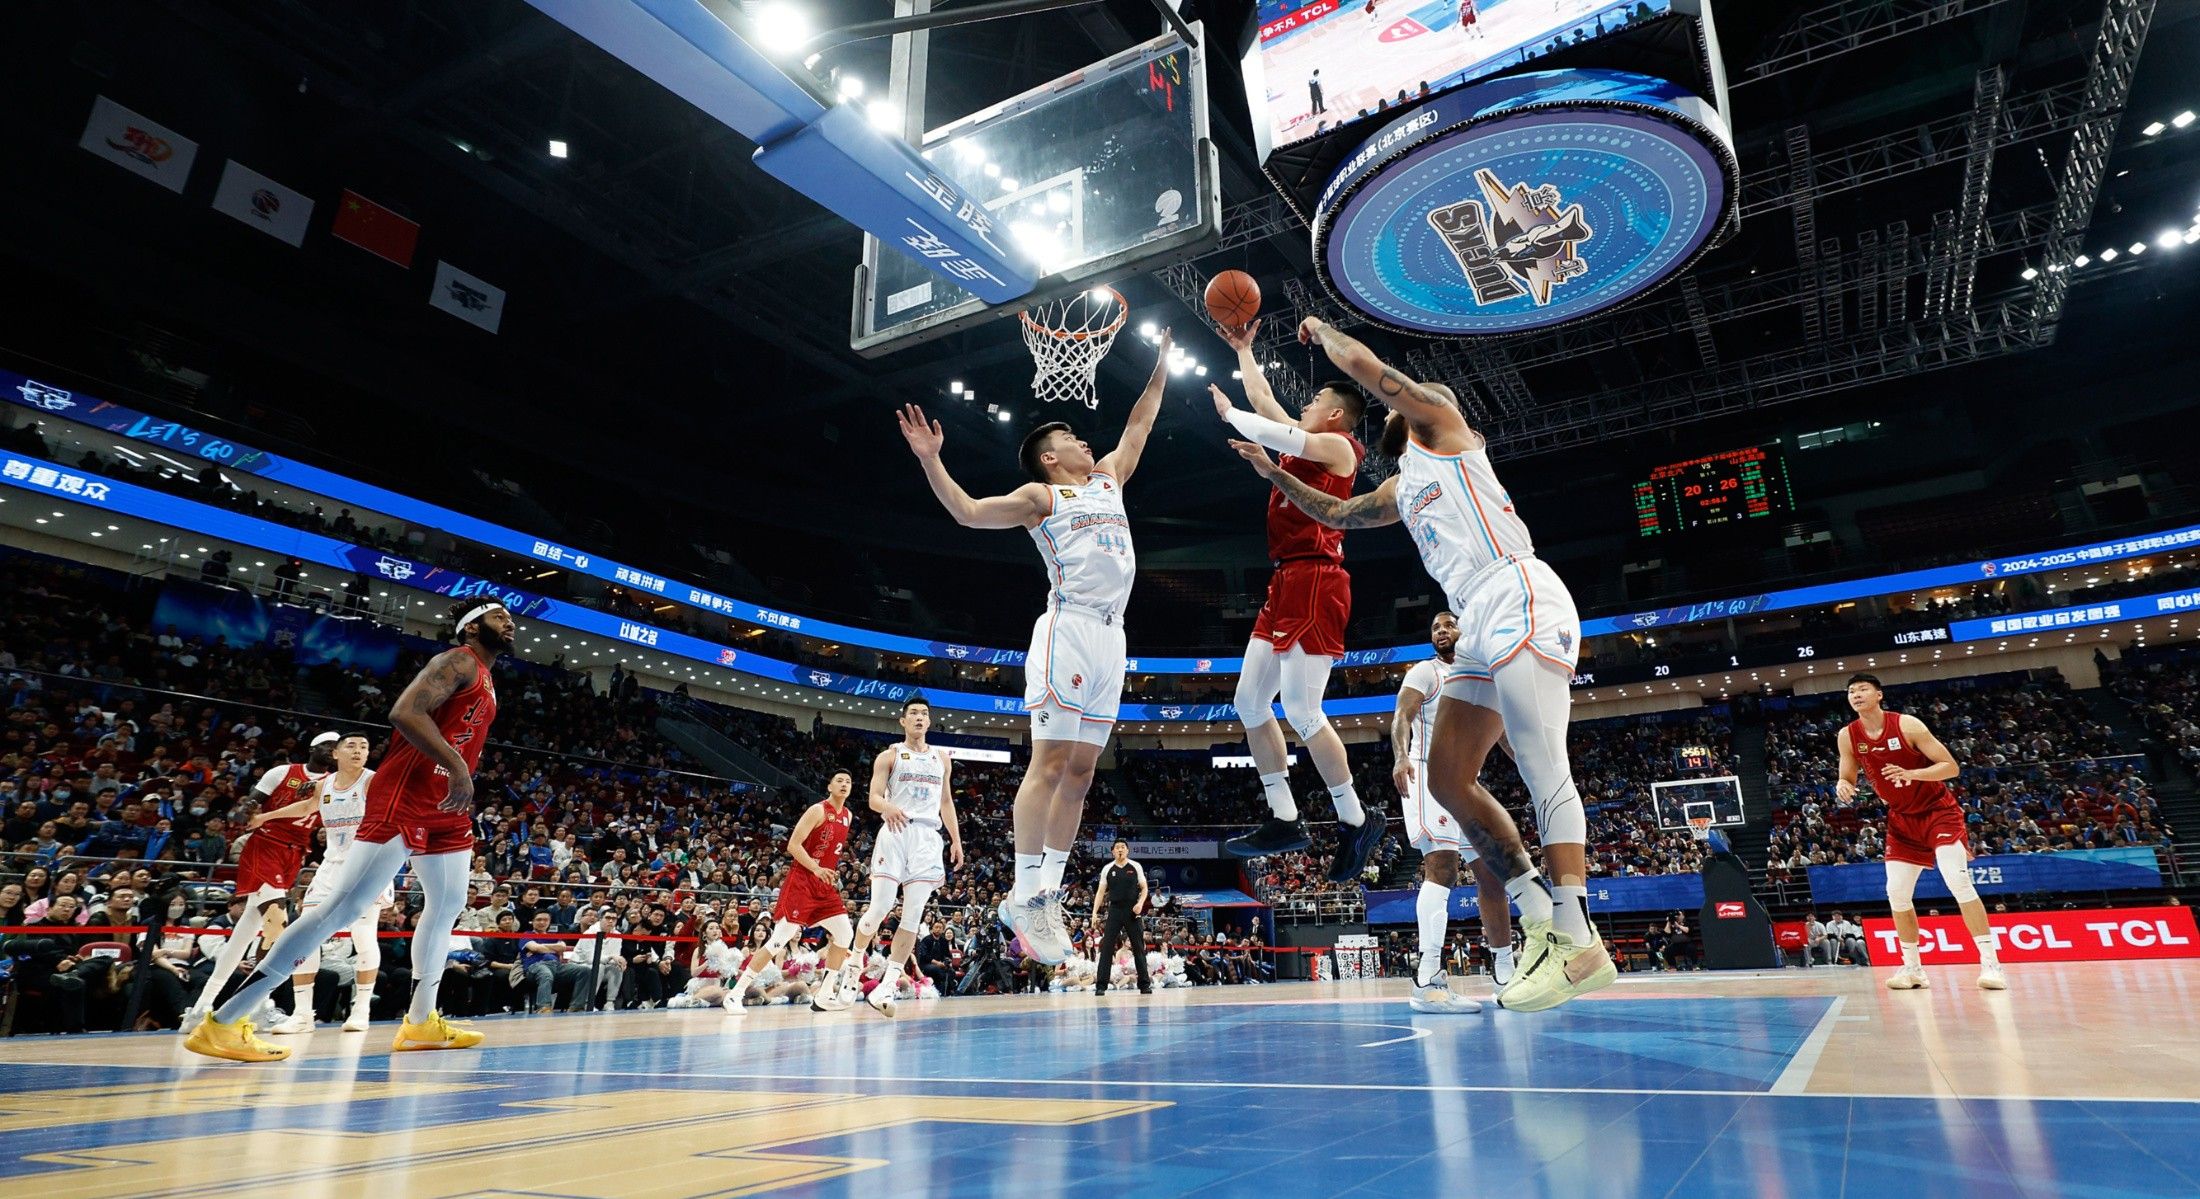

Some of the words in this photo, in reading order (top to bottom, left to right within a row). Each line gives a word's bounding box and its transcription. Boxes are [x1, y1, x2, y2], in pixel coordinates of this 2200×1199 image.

[1301, 3, 1332, 20] TCL
[1260, 18, 1296, 38] 争不凡
[905, 171, 1006, 257] 金陵
[1432, 202, 1528, 304] DUCKS
[125, 416, 200, 446] LET'S
[200, 440, 233, 461] GO
[2, 459, 110, 501] 尊重观众
[1684, 485, 1702, 498] 20
[1720, 478, 1738, 491] 26
[1096, 531, 1125, 555] 44
[2002, 552, 2076, 573] 2024-2025
[533, 541, 589, 569] 团结一心
[615, 567, 666, 593] 顽强拼搏
[689, 590, 734, 613] 奋勇争先
[756, 608, 801, 630] 不负使命
[502, 592, 523, 610] GO
[1688, 598, 1724, 622] LET'S
[1729, 600, 1745, 615] GO
[992, 650, 1023, 664] LET'S
[1362, 651, 1377, 665] GO
[1655, 665, 1670, 676] 20
[1731, 655, 1739, 667] 1
[1798, 646, 1814, 658] 26
[1894, 628, 1947, 645] 山东高速
[853, 679, 886, 696] LET'S
[887, 685, 904, 699] GO
[1687, 758, 1701, 768] 14
[2085, 919, 2190, 947] TCL
